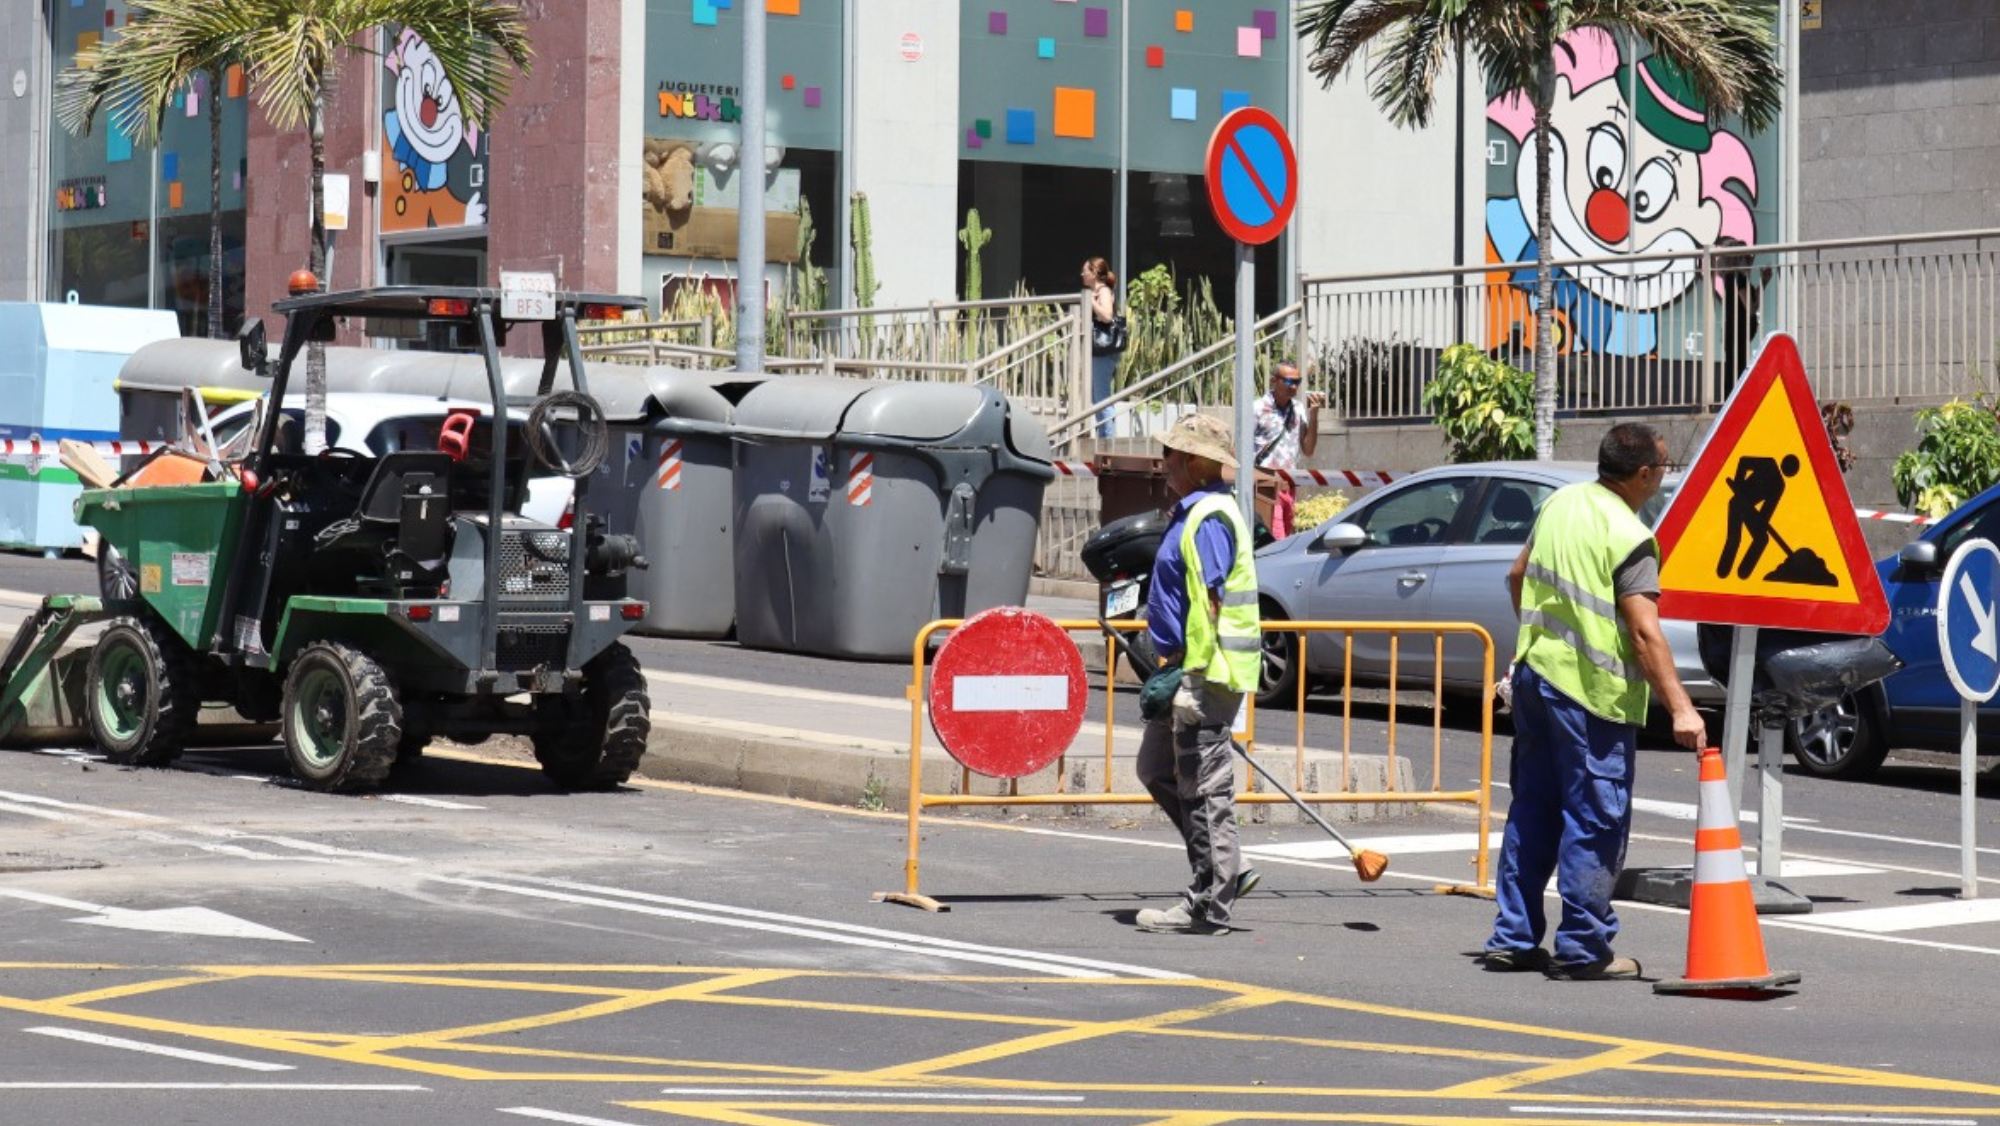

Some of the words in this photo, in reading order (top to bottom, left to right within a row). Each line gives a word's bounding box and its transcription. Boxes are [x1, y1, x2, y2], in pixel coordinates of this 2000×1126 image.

[658, 81, 739, 97] JUGUETERI
[658, 91, 743, 124] Nikk
[517, 298, 543, 315] BFS
